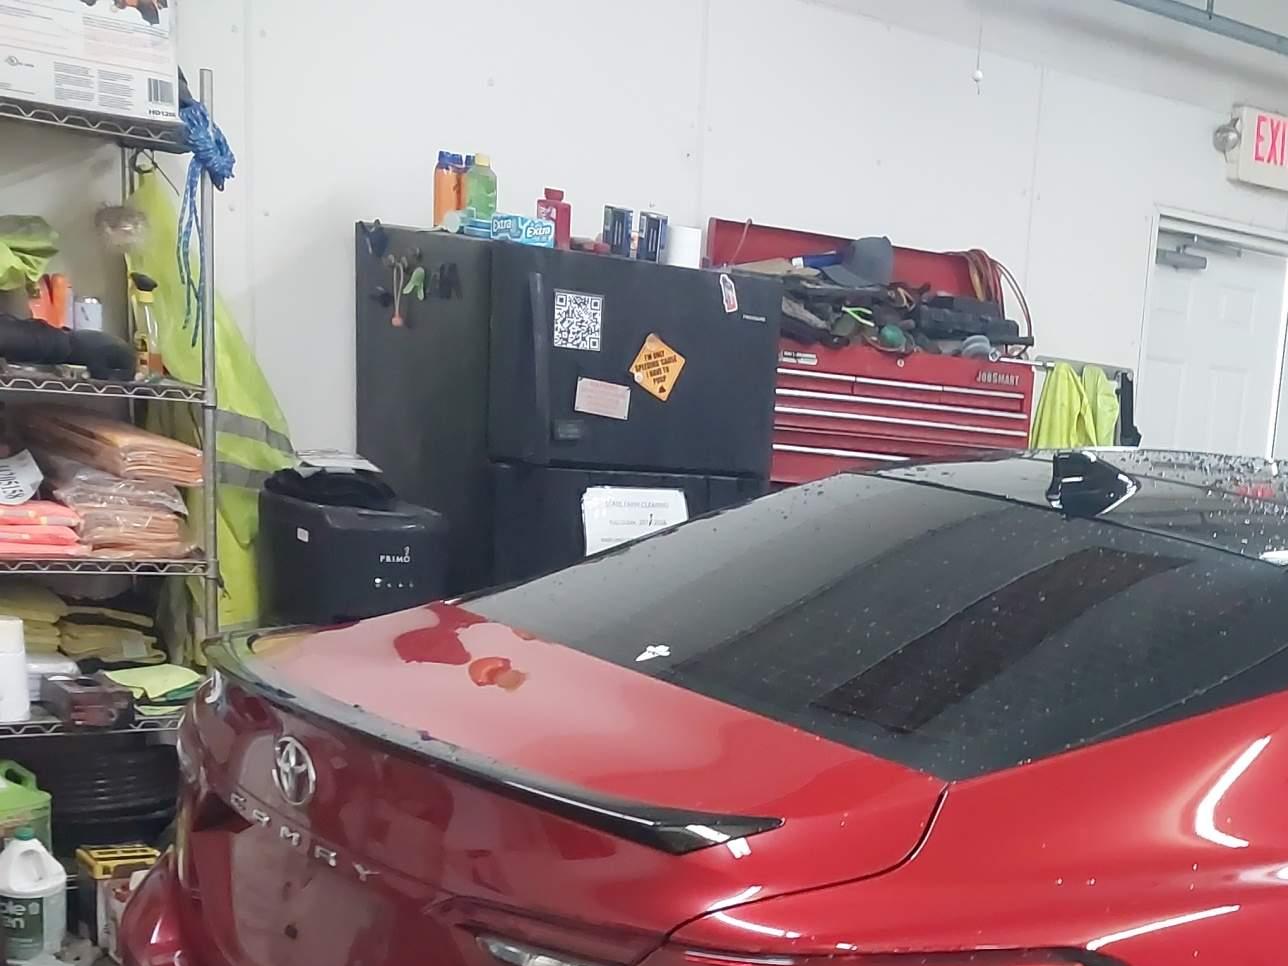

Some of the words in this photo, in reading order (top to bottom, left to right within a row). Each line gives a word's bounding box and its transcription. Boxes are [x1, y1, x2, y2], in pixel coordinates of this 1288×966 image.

[526, 225, 551, 239] Extra
[976, 371, 1019, 386] JOBSMART
[380, 554, 411, 563] PRIMO
[230, 792, 381, 881] CAMRY
